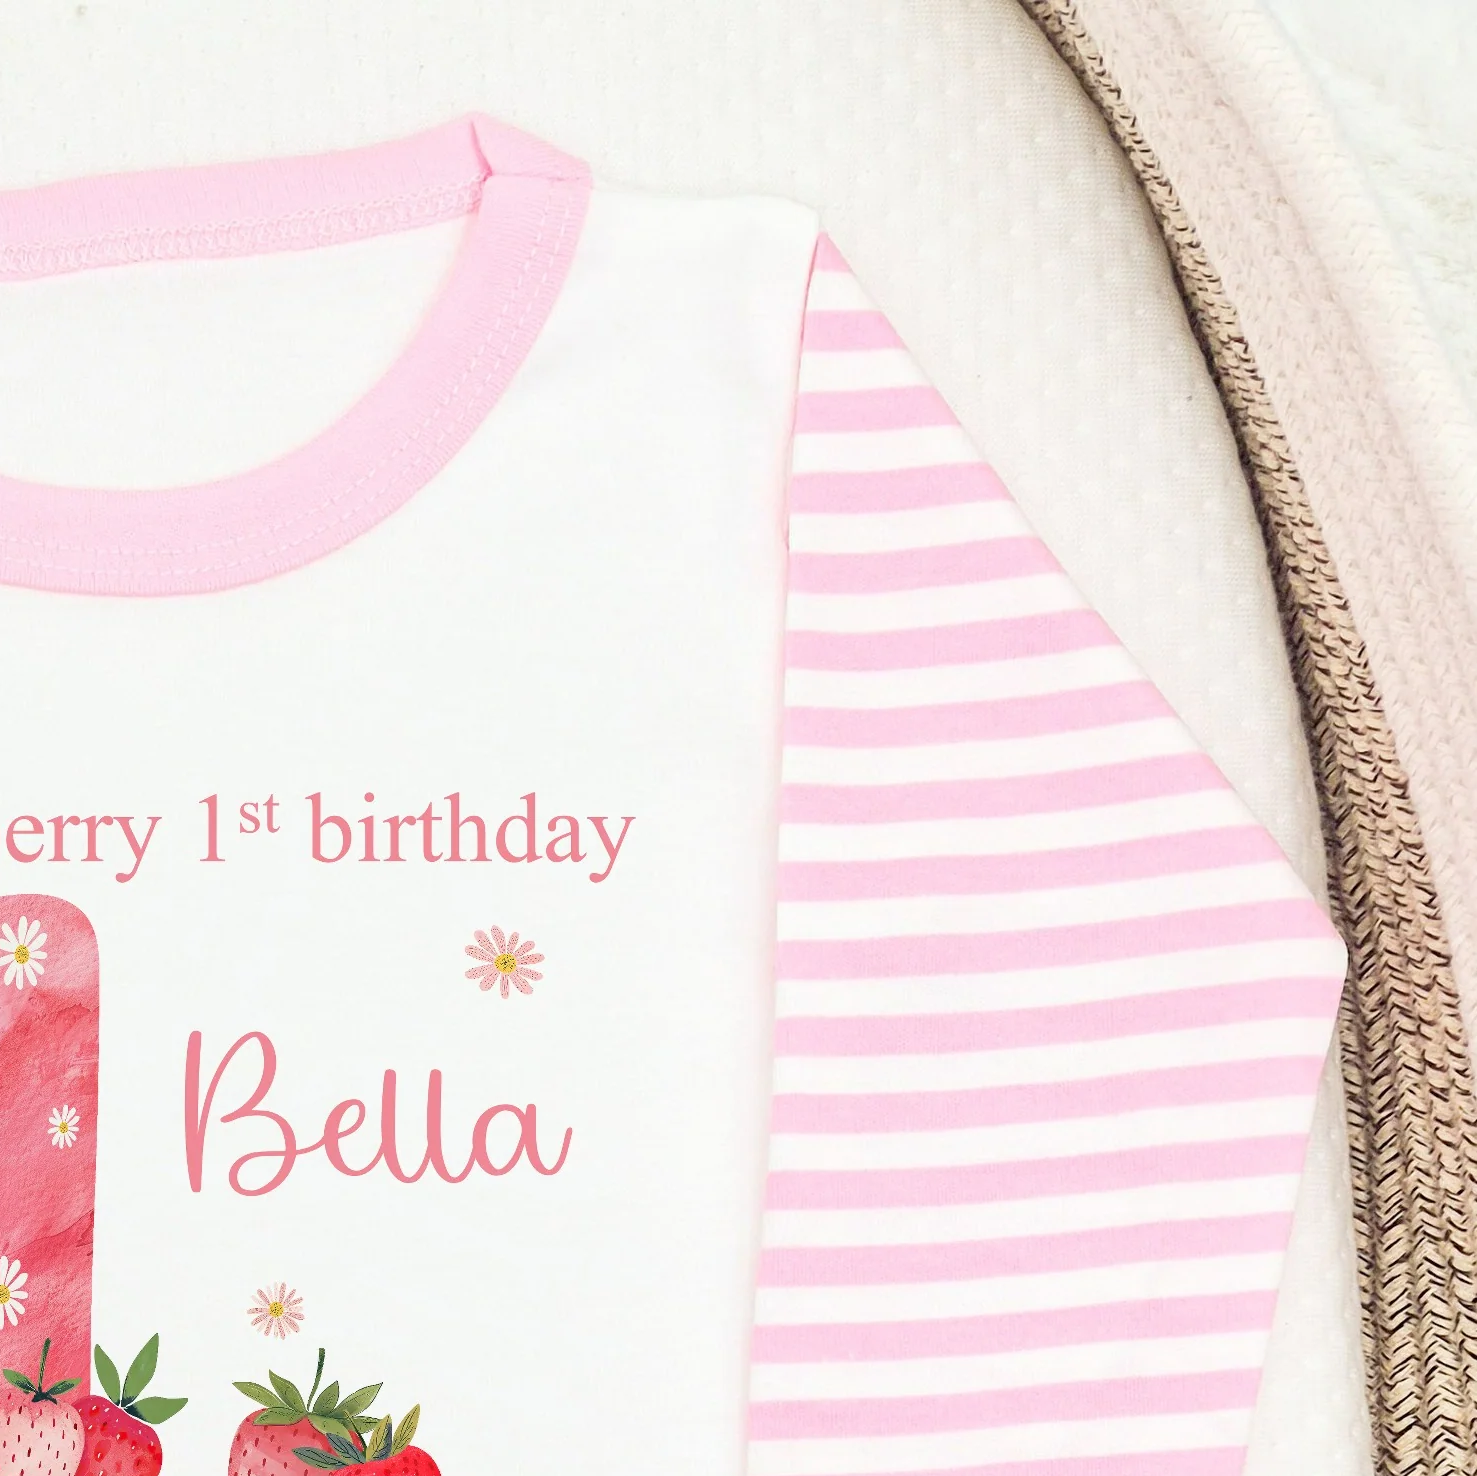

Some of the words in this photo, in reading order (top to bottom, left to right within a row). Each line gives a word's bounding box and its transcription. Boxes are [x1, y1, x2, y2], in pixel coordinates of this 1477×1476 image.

[199, 793, 281, 863] 1st
[304, 791, 636, 884] birthday
[183, 1029, 574, 1197] Bella
